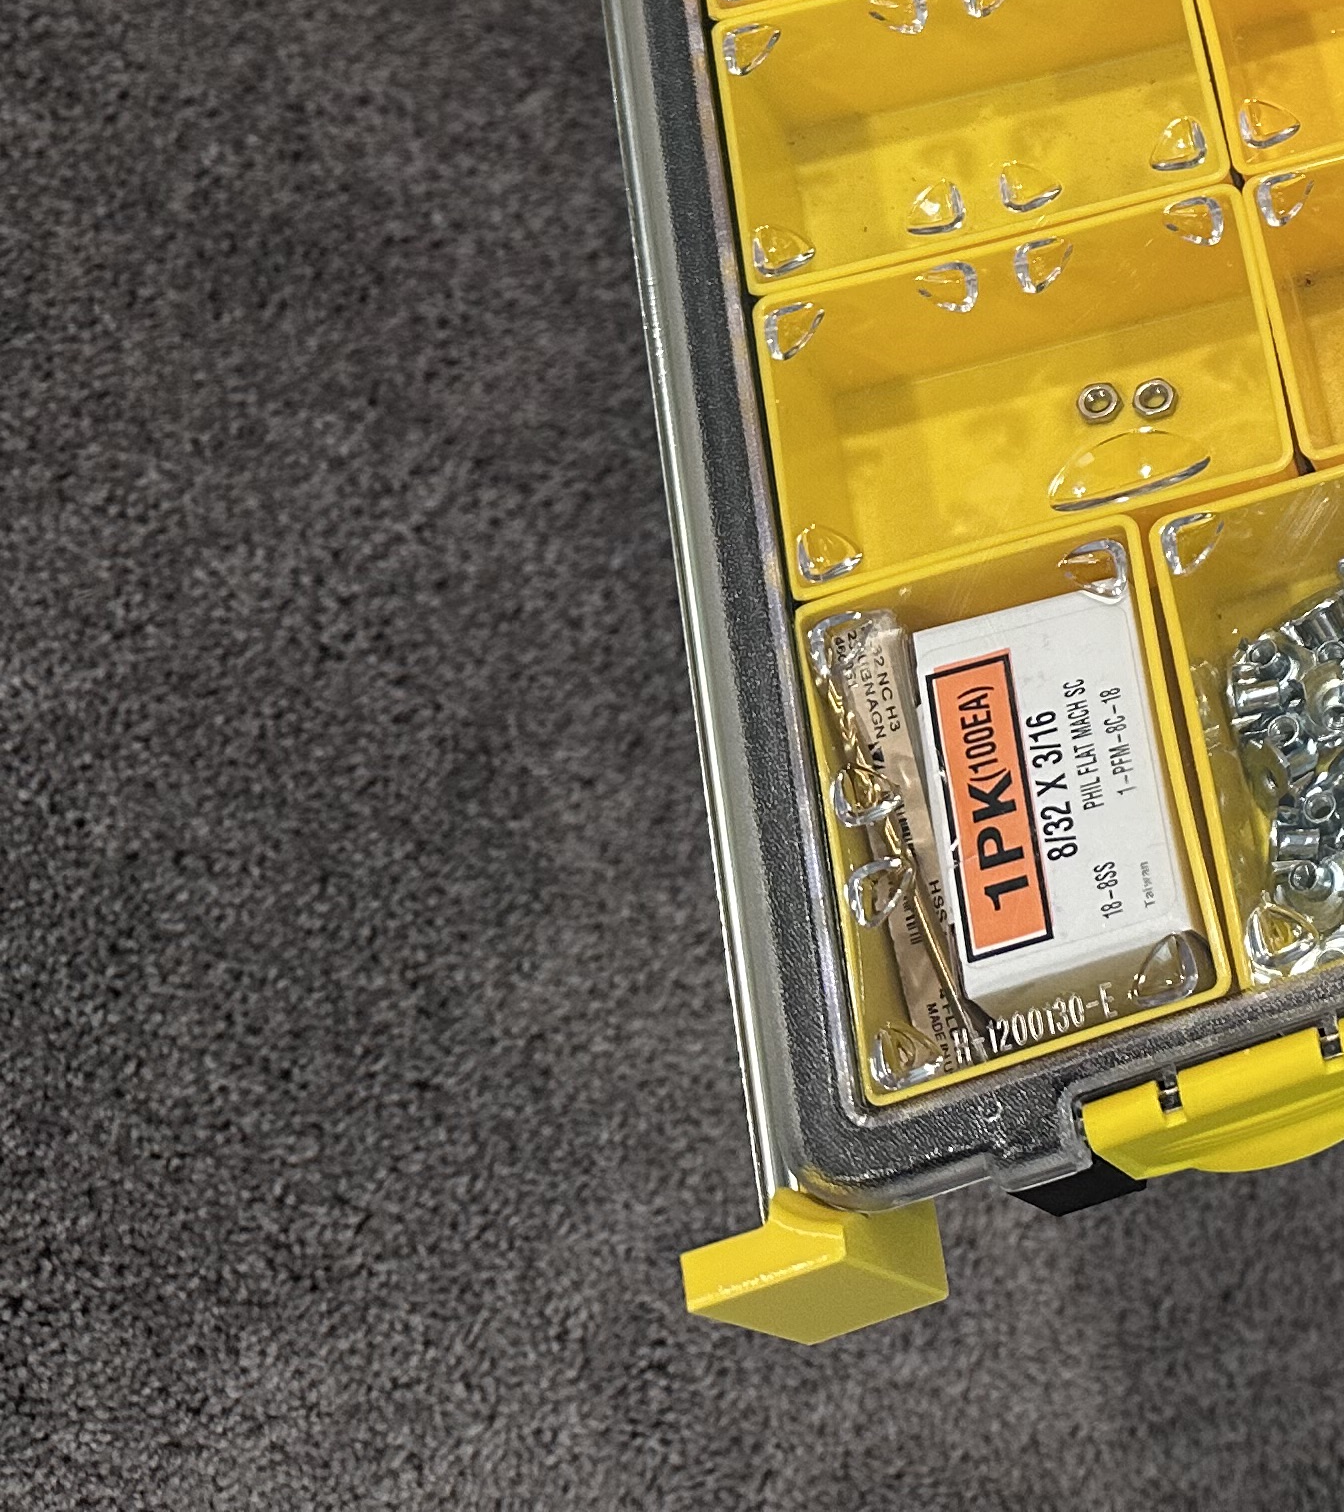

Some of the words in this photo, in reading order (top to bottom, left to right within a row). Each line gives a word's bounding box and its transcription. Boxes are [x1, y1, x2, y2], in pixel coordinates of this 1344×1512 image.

[876, 671, 893, 702] NC
[885, 705, 901, 733] H3
[1062, 678, 1087, 699] SC
[1025, 709, 1064, 769] 3/16
[1065, 699, 1094, 741] MACH
[1073, 742, 1100, 777] FLAT
[1034, 772, 1069, 798] X
[1079, 775, 1105, 811] PHIL
[1039, 800, 1079, 862] 8/32
[928, 879, 947, 923] HSS
[1093, 860, 1124, 920] 18-8SS
[1139, 860, 1156, 909] Taiwan
[926, 1002, 945, 1042] MADE
